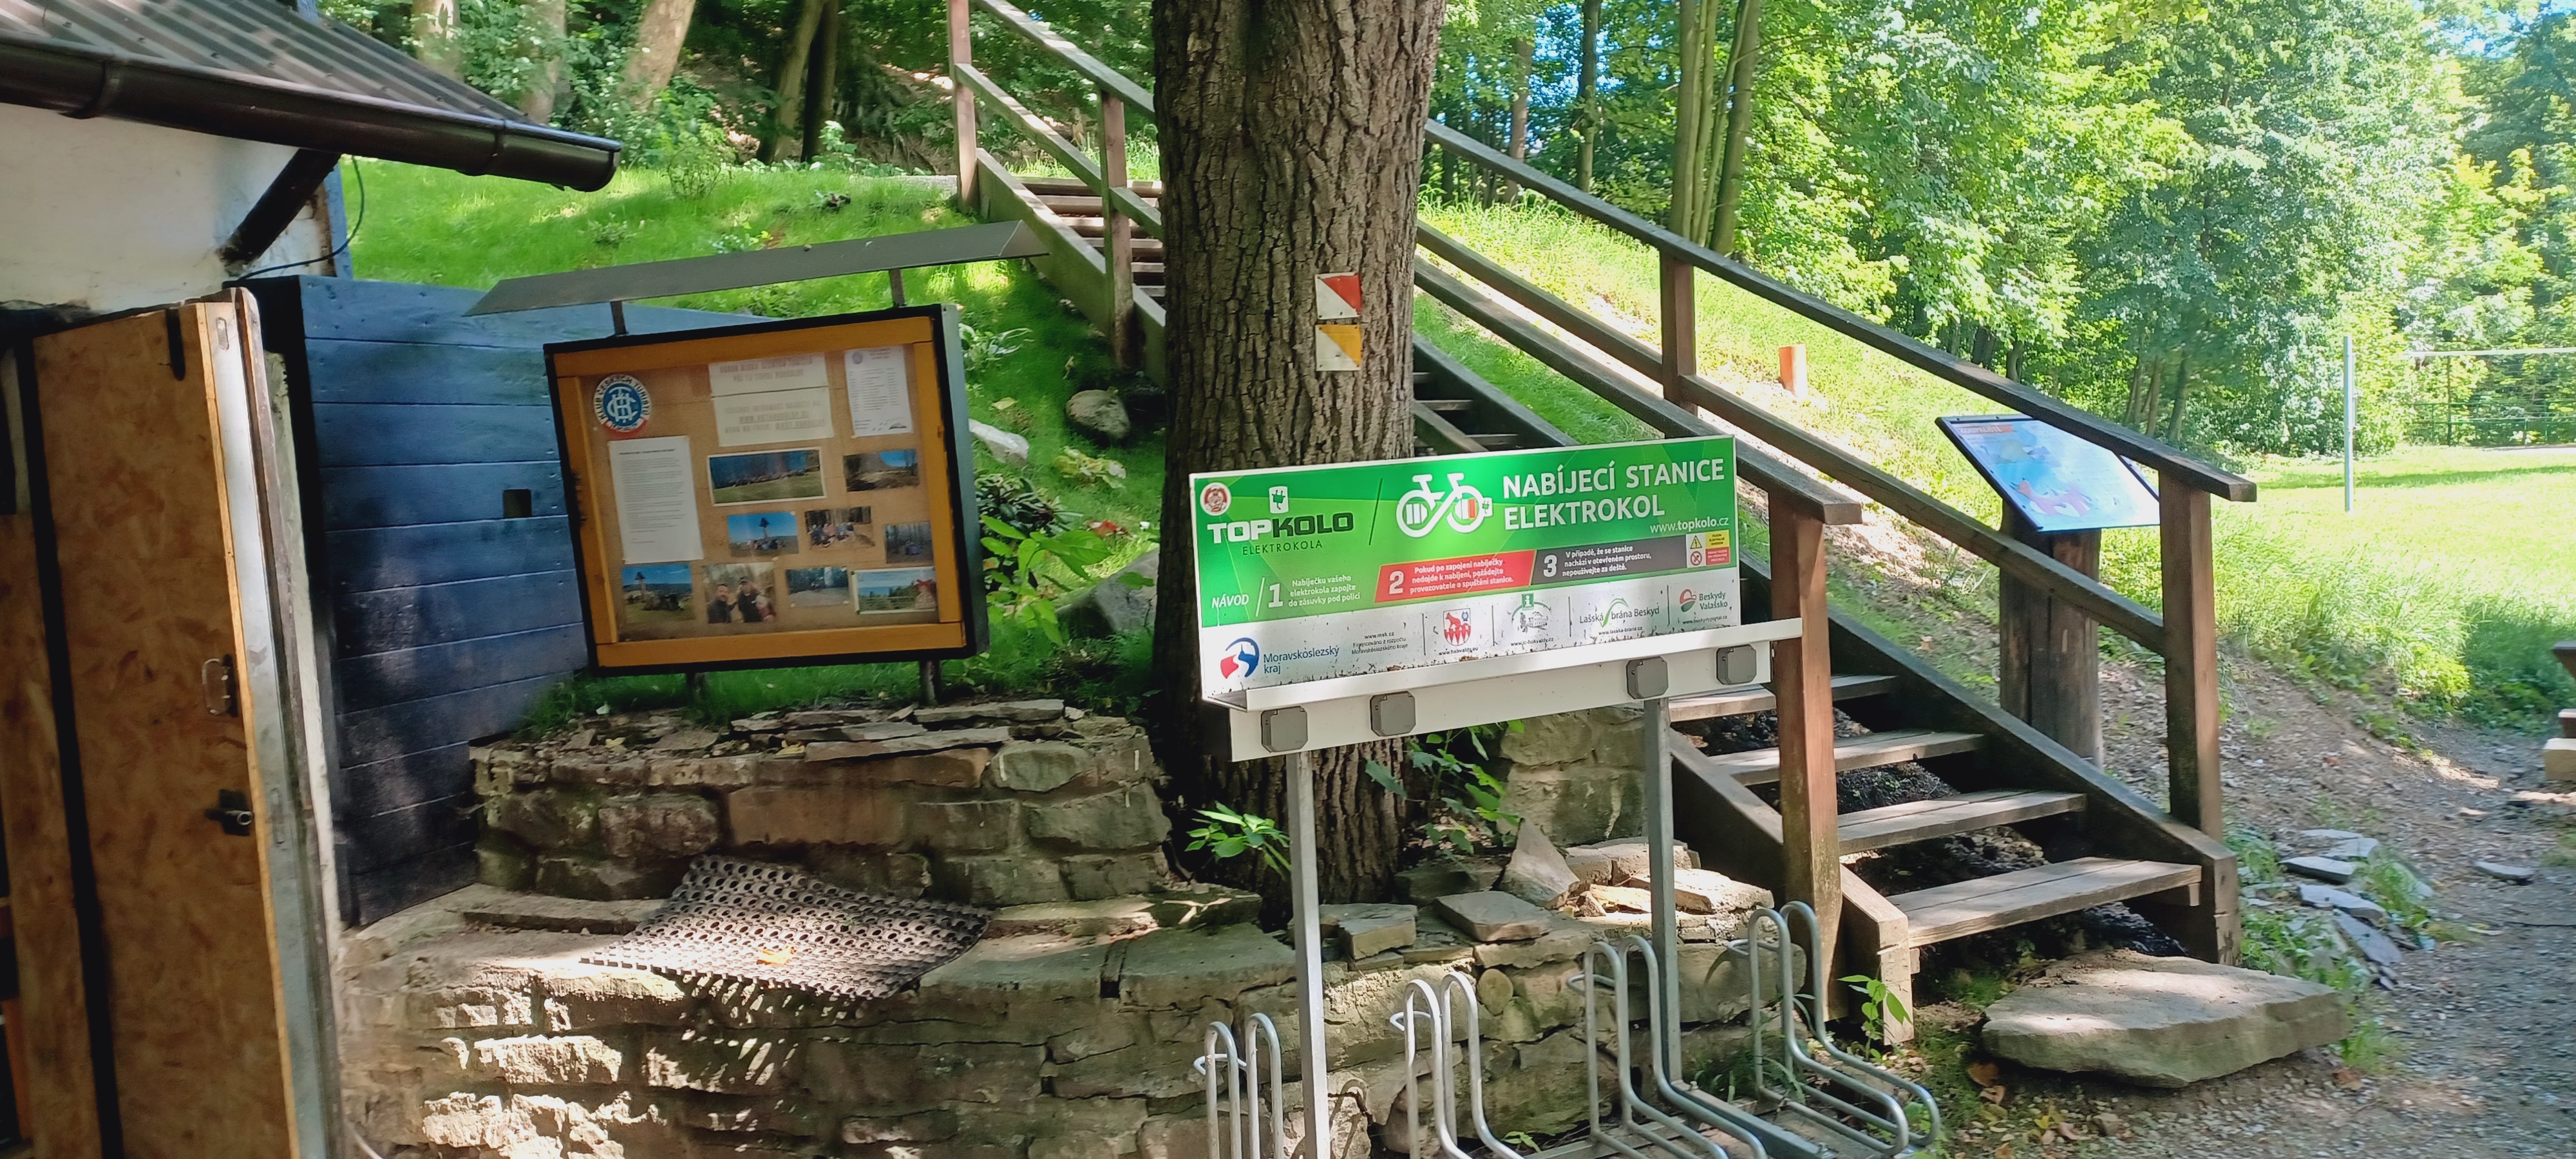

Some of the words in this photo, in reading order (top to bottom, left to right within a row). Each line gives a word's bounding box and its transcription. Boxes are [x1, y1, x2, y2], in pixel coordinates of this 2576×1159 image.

[1503, 460, 1615, 498] NABÍJECÍ
[1626, 458, 1725, 489] STANICE
[1504, 495, 1665, 530] ELEKTROKOL
[1207, 513, 1354, 543] TOPKOLO
[1650, 516, 1730, 533] www.topkolo.cz
[1243, 540, 1323, 555] ELEKTROKOLA
[1571, 549, 1596, 559] případě,
[1612, 545, 1633, 553] stanice
[1543, 554, 1557, 577] 3
[1564, 558, 1587, 567] nachází
[1593, 554, 1624, 565] otevřeném
[1625, 552, 1652, 562] prostoru,
[1414, 564, 1435, 574] Pokud
[1445, 561, 1472, 572] zapojení
[1562, 565, 1600, 577] nepoužívejte
[1609, 563, 1627, 572] deště.
[1292, 576, 1327, 587] Nabíječku
[1327, 575, 1352, 583] vašeho
[1388, 570, 1405, 594] 2
[1412, 574, 1438, 584] nedojde
[1439, 572, 1444, 581] k
[1472, 567, 1504, 578] požádejte
[1268, 583, 1283, 608] 1
[1290, 587, 1329, 597] elektrokola
[1331, 584, 1356, 594] zapojte
[1410, 582, 1455, 594] provozovatele
[1699, 590, 1726, 601] Beskydy
[1211, 594, 1249, 608] NÁVOD
[1299, 596, 1326, 607] zásuvky
[1327, 595, 1341, 604] pod
[1341, 592, 1361, 602] policí
[1700, 601, 1728, 610] Valašsko
[1579, 612, 1604, 624] Lašská
[1611, 607, 1633, 619] brána
[1634, 605, 1660, 617] Beskyd
[1264, 645, 1340, 663] Moravskoslezský
[1264, 663, 1281, 674] kraj
